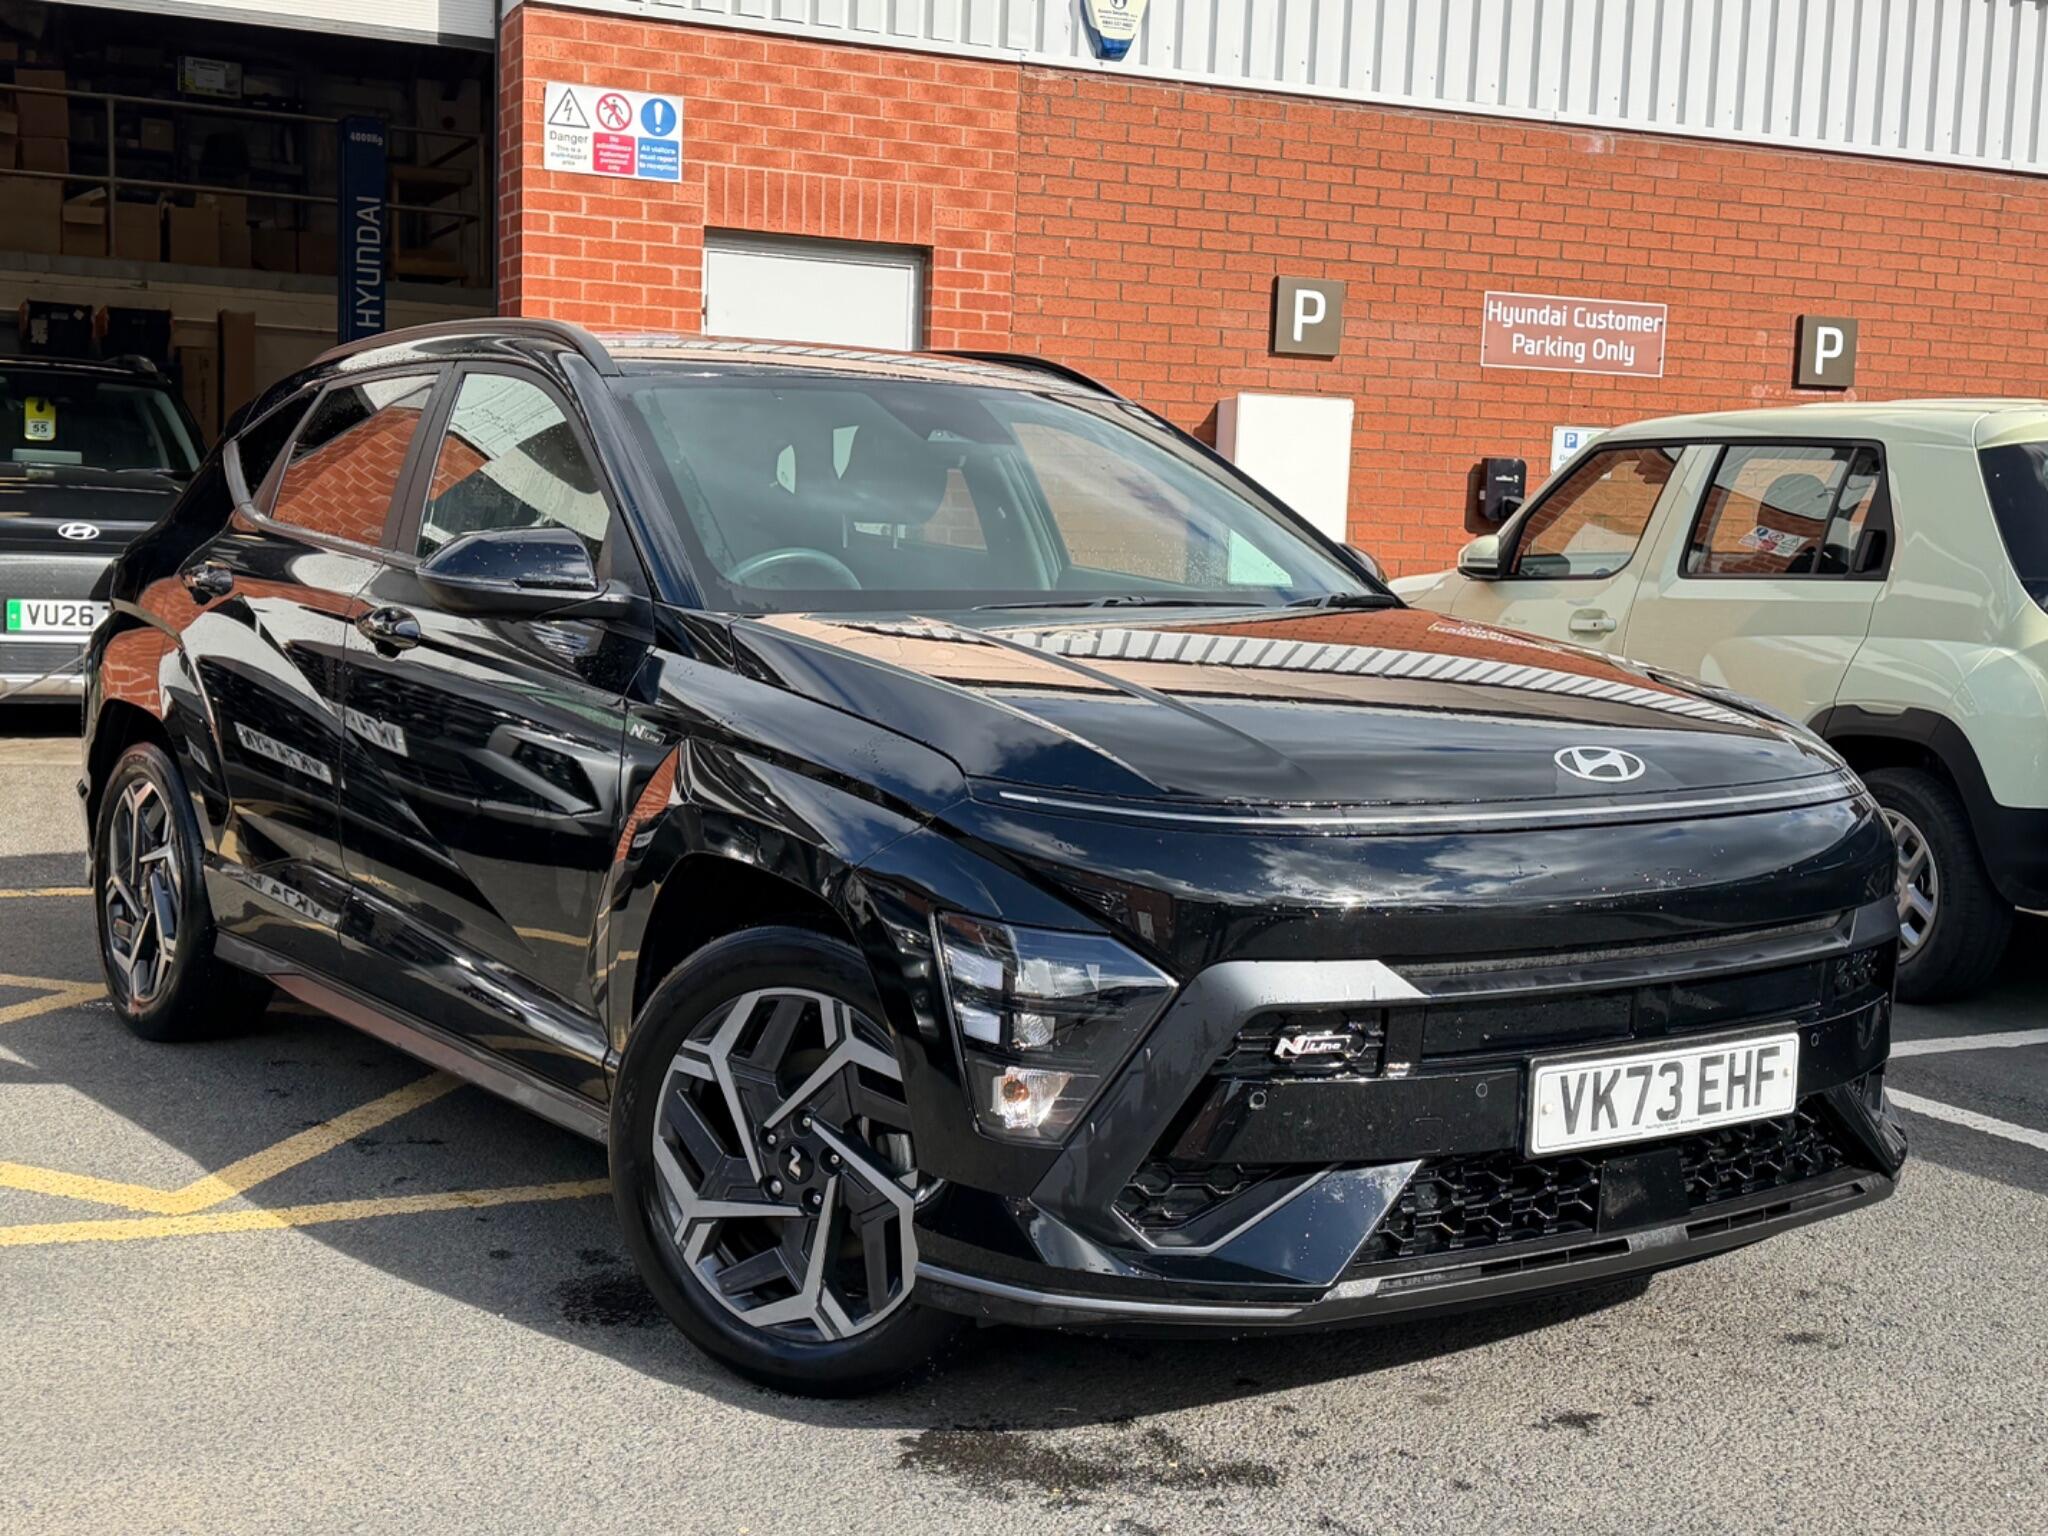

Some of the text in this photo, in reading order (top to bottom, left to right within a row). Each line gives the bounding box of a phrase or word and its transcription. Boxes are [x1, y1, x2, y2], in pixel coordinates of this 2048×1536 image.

[549, 130, 588, 145] Danger
[356, 196, 381, 328] HYUNDAI
[1293, 289, 1326, 342] P
[1487, 300, 1663, 333] Hyundai Customer
[1511, 333, 1635, 366] Parking Only
[1815, 326, 1844, 375] P
[32, 423, 48, 433] 55
[1566, 433, 1577, 447] P
[26, 604, 94, 626] VU26
[1559, 1046, 1781, 1135] VK73 EHF
